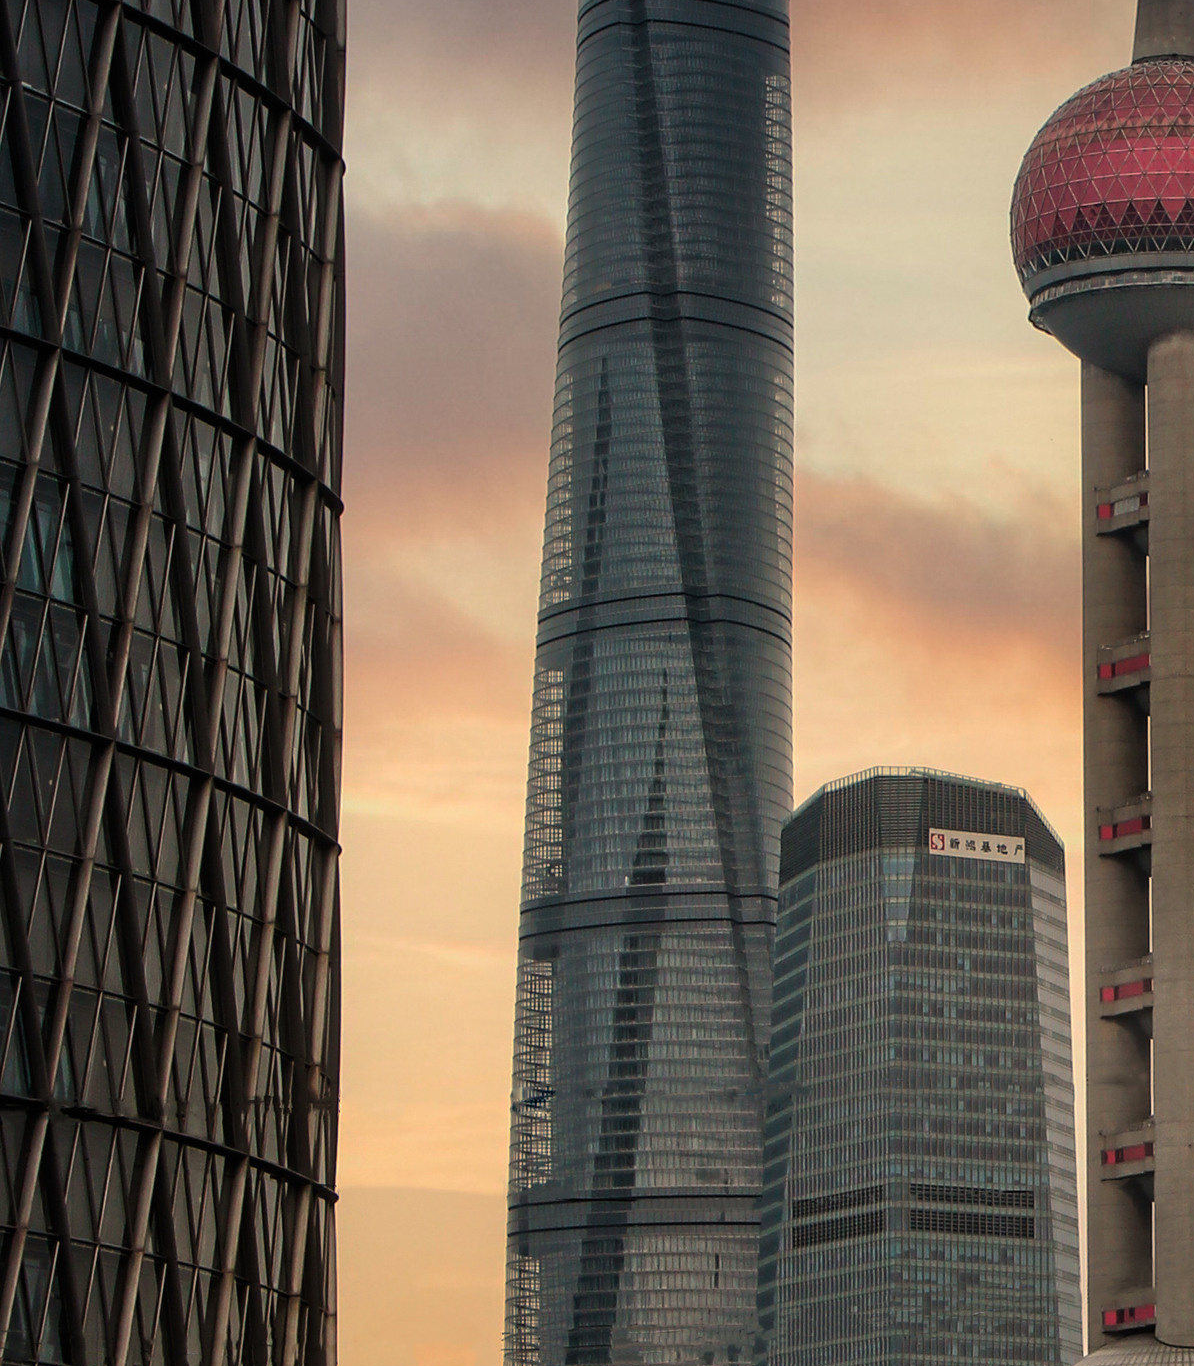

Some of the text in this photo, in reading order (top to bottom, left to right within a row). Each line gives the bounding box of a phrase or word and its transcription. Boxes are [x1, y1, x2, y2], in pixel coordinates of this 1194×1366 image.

[949, 838, 1023, 855] 新鸿基地产
